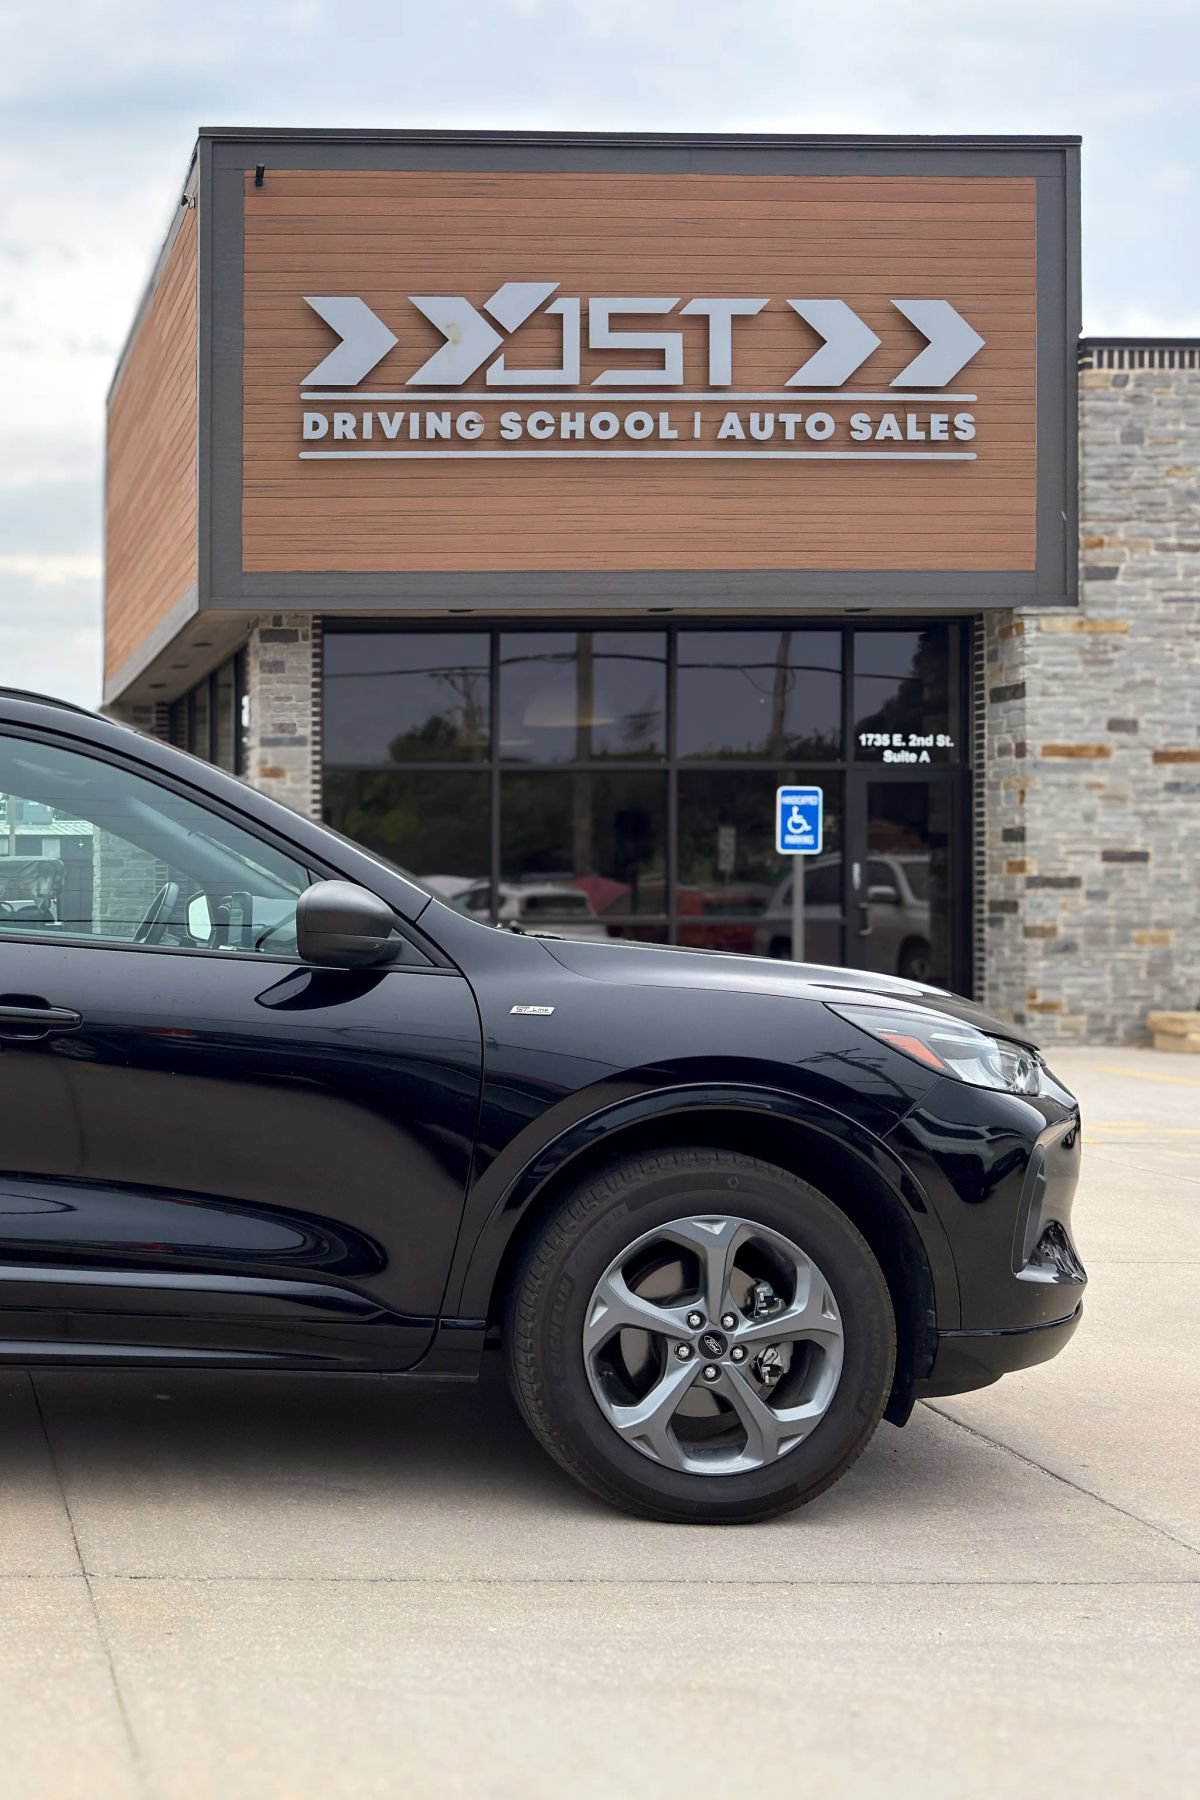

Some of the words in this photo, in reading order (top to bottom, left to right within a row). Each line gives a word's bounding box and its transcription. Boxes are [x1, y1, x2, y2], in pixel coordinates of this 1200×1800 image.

[302, 411, 486, 440] DRIVING
[499, 410, 679, 440] SCHOOL
[716, 410, 836, 441] AUTO
[849, 411, 977, 441] SALES
[858, 733, 890, 747] 1735
[892, 733, 906, 747] E.
[908, 734, 933, 747] 2nd
[935, 734, 955, 748] St.
[882, 749, 918, 764] Suite
[918, 750, 931, 764] A
